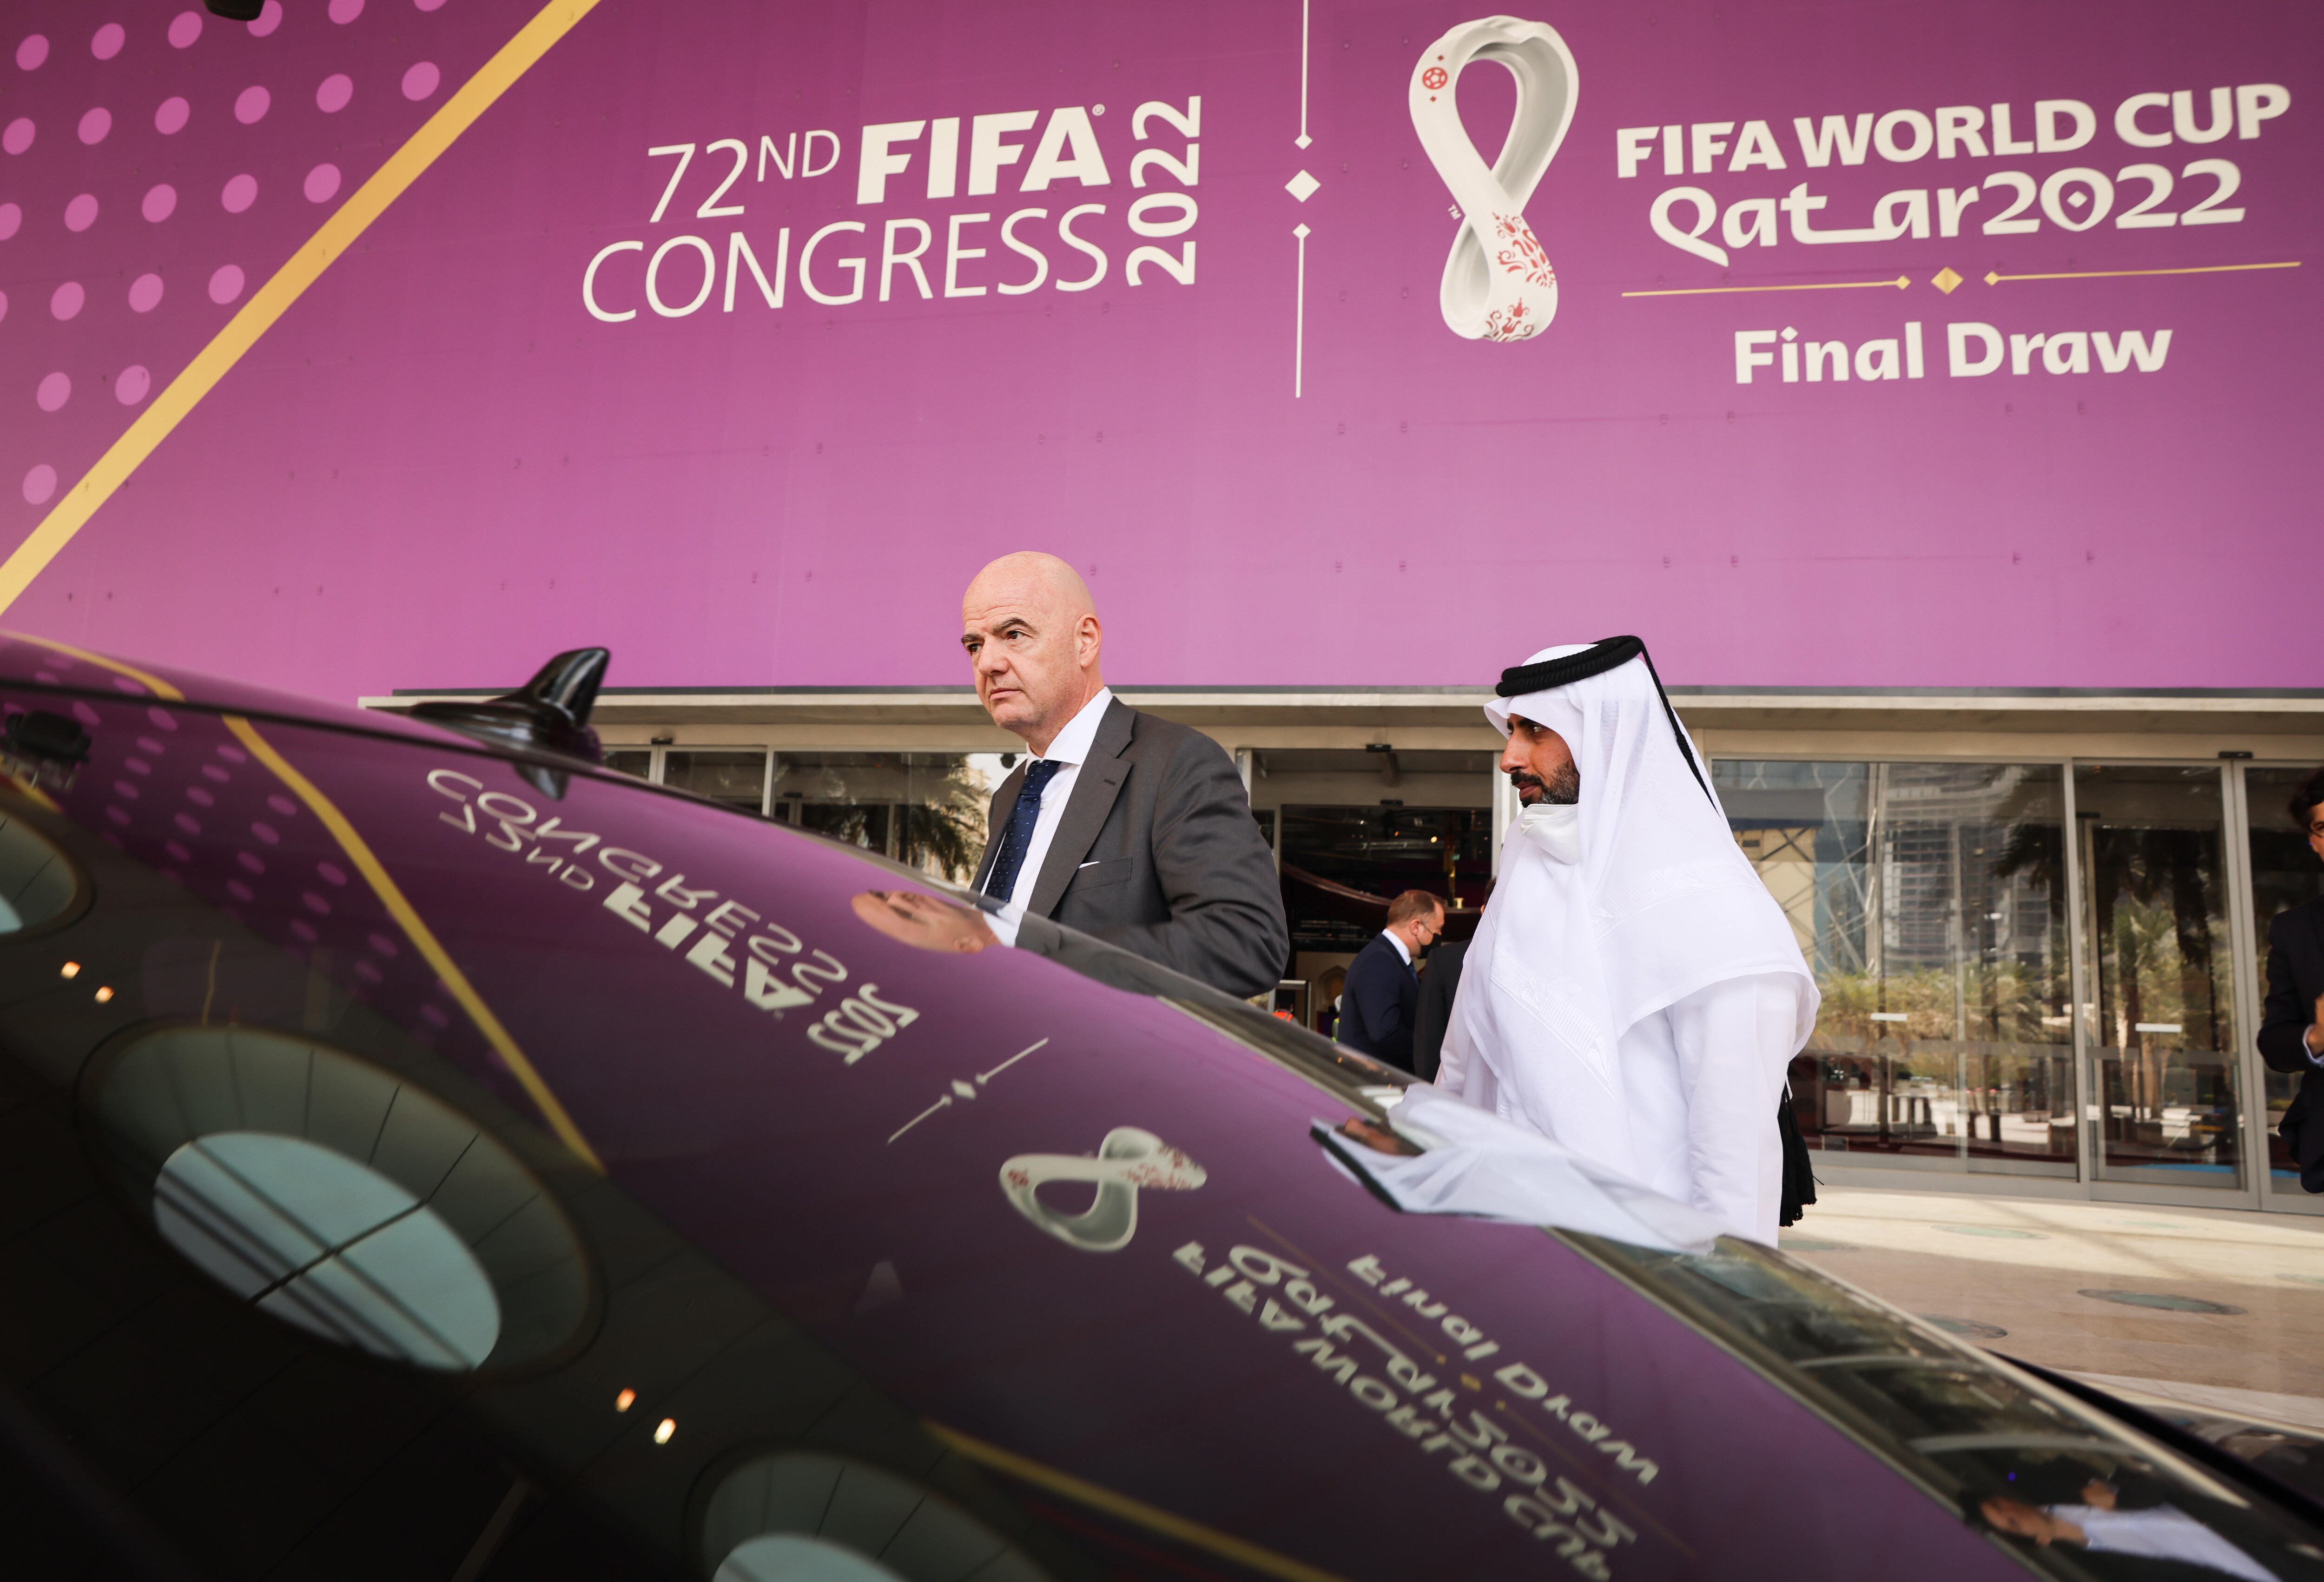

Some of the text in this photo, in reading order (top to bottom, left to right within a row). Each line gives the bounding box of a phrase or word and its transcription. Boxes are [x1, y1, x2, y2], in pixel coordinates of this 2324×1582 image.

[647, 106, 1111, 223] 72ND FIFA
[1617, 84, 2291, 179] FIFA WORLD CUP
[1125, 95, 1201, 287] 2022
[582, 204, 1109, 323] CONGRESS
[1734, 321, 2173, 384] Final Draw
